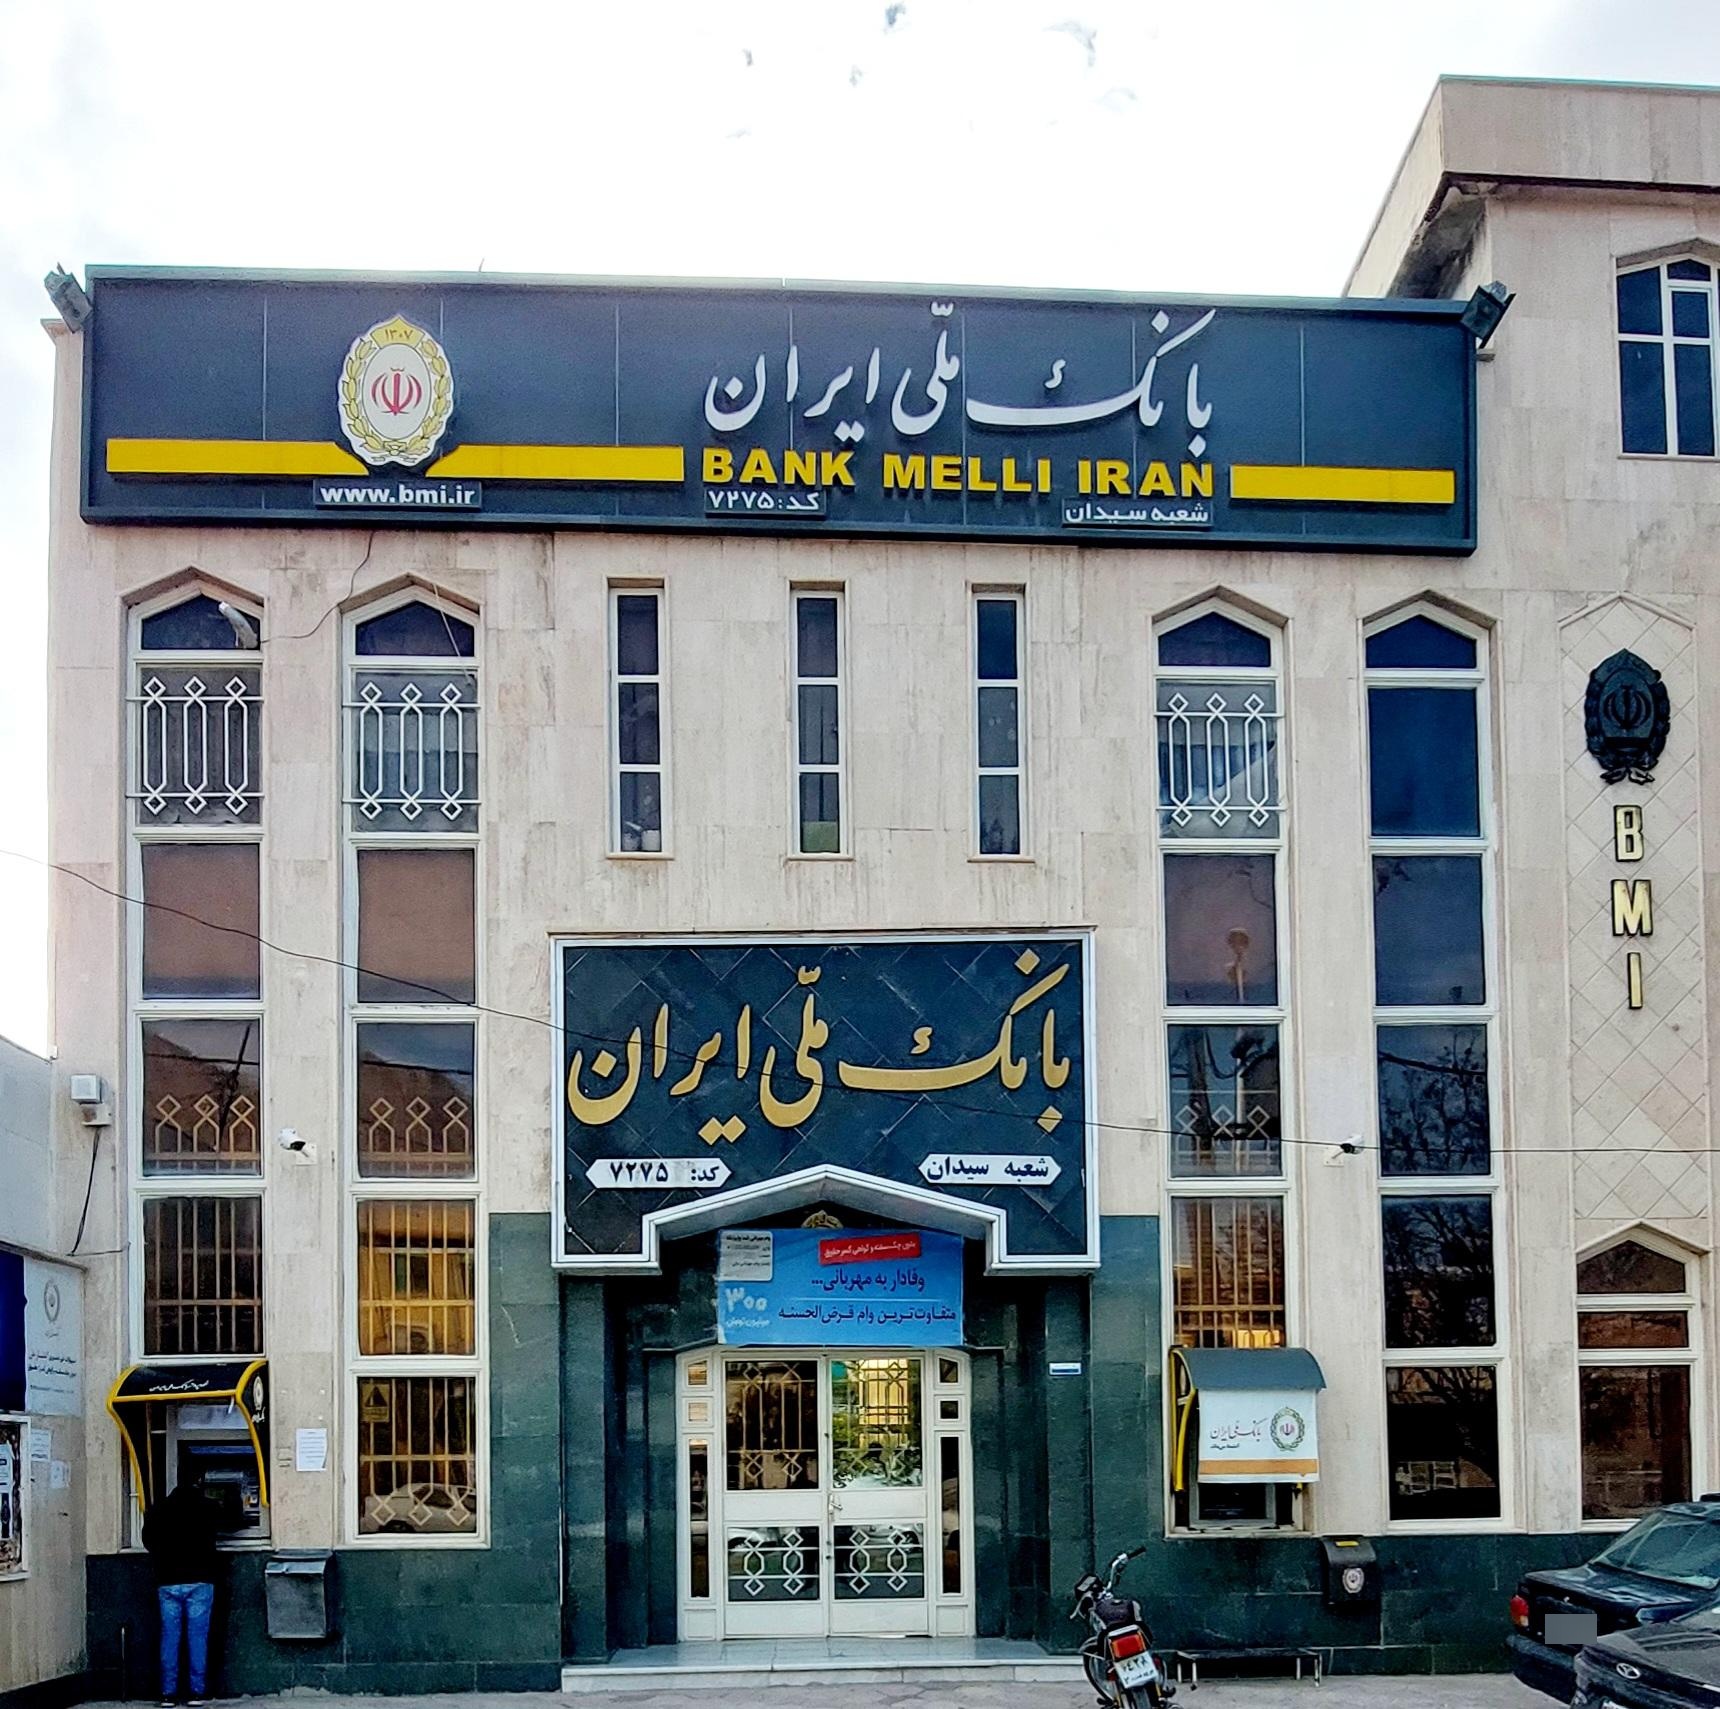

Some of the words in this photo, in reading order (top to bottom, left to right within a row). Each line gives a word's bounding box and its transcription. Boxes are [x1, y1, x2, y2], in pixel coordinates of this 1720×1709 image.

[704, 344, 881, 444] ایران
[702, 447, 856, 487] BANK
[883, 453, 1051, 494] MELLI
[1077, 458, 1214, 499] IRAN
[319, 484, 476, 505] www.bmi.ir
[1065, 502, 1147, 523] سیدان
[1150, 502, 1209, 524] شعبه
[567, 1001, 752, 1146] ایران
[609, 1161, 669, 1183] ۷۲۷۵
[926, 1156, 989, 1181] سیدان
[1003, 1157, 1049, 1183] شعبه
[875, 1273, 888, 1291] به
[890, 1268, 925, 1292] وفادار
[857, 1305, 875, 1324] وام
